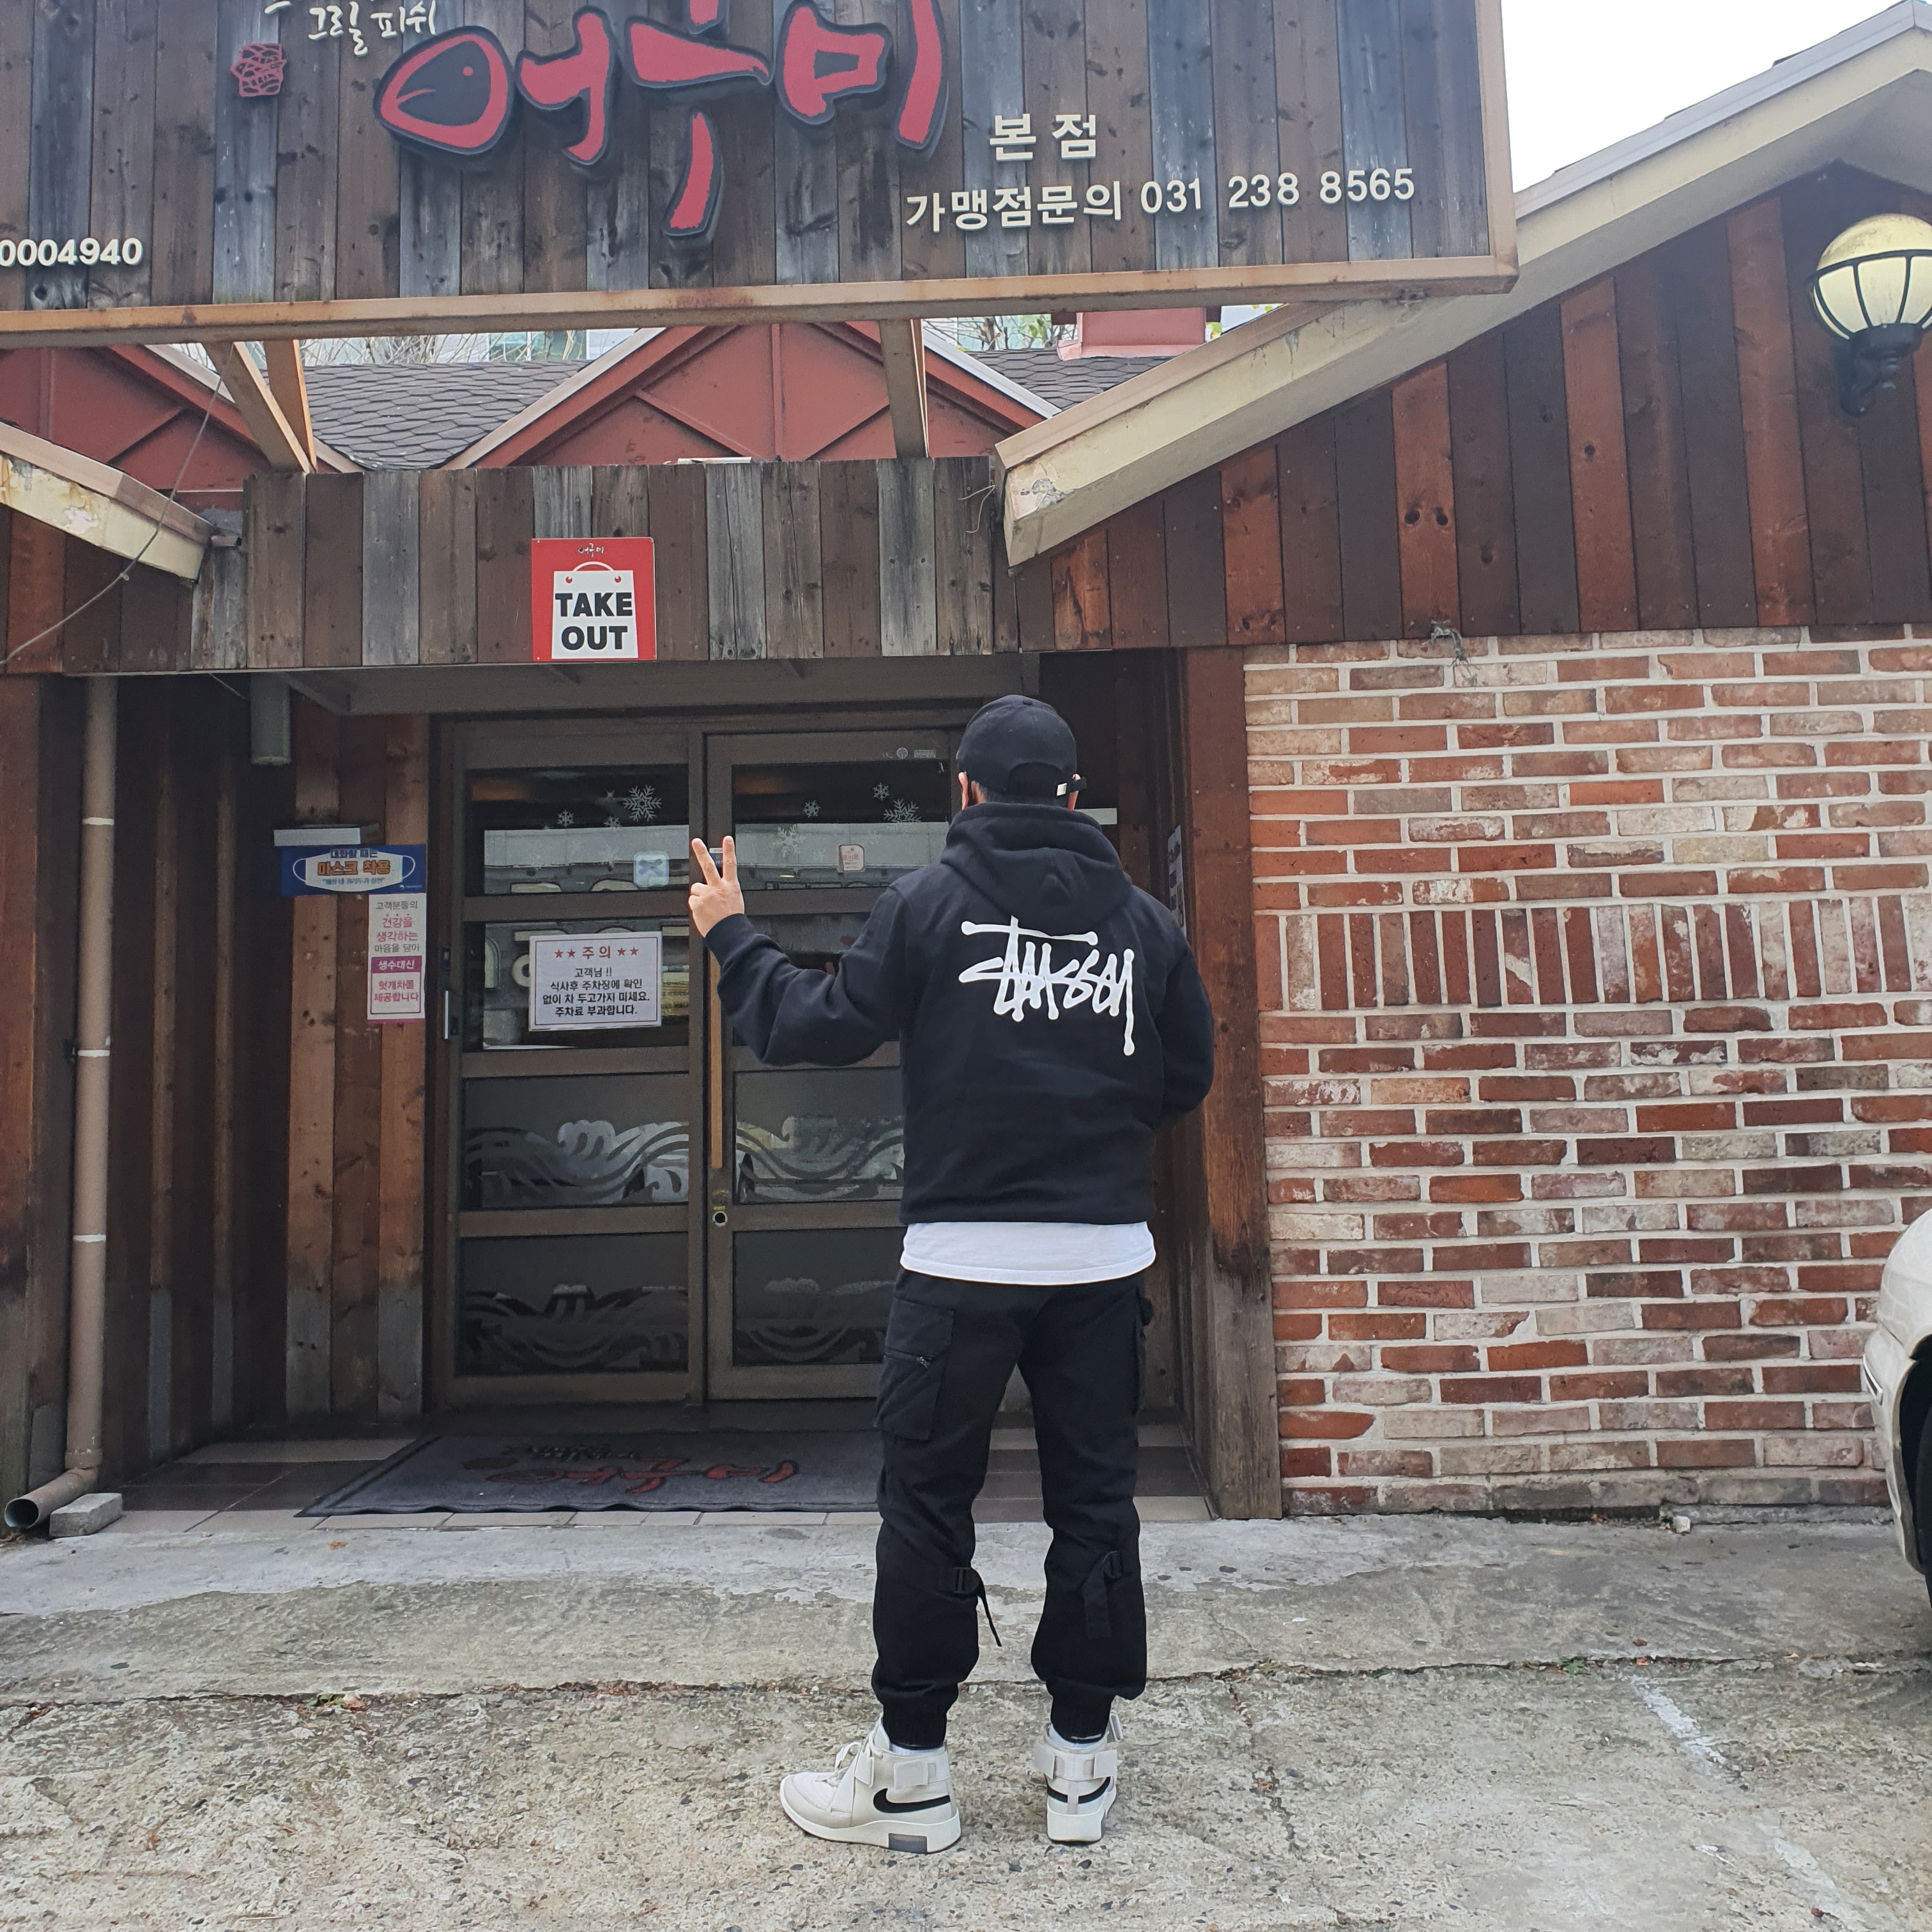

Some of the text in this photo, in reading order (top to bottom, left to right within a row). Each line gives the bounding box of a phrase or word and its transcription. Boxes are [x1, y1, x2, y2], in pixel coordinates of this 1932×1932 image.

[308, 0, 436, 57] 그릴 피쉬
[906, 168, 1416, 233] 가맹점문의 031 238 8565
[555, 592, 633, 617] TAKE
[561, 625, 628, 650] OUT
[317, 859, 391, 876] 마스크 착용
[382, 916, 413, 928] 건강을
[376, 930, 418, 942] 생각하는
[374, 942, 420, 954] 마음을 담아
[378, 958, 415, 970] 생수대신
[574, 967, 602, 978] 고객님
[550, 978, 643, 992] 식사후 주차장에 확인
[542, 991, 650, 1005] 없이 차 두고가지 미세요.
[555, 1004, 638, 1017] 주차료 부과합니다.
